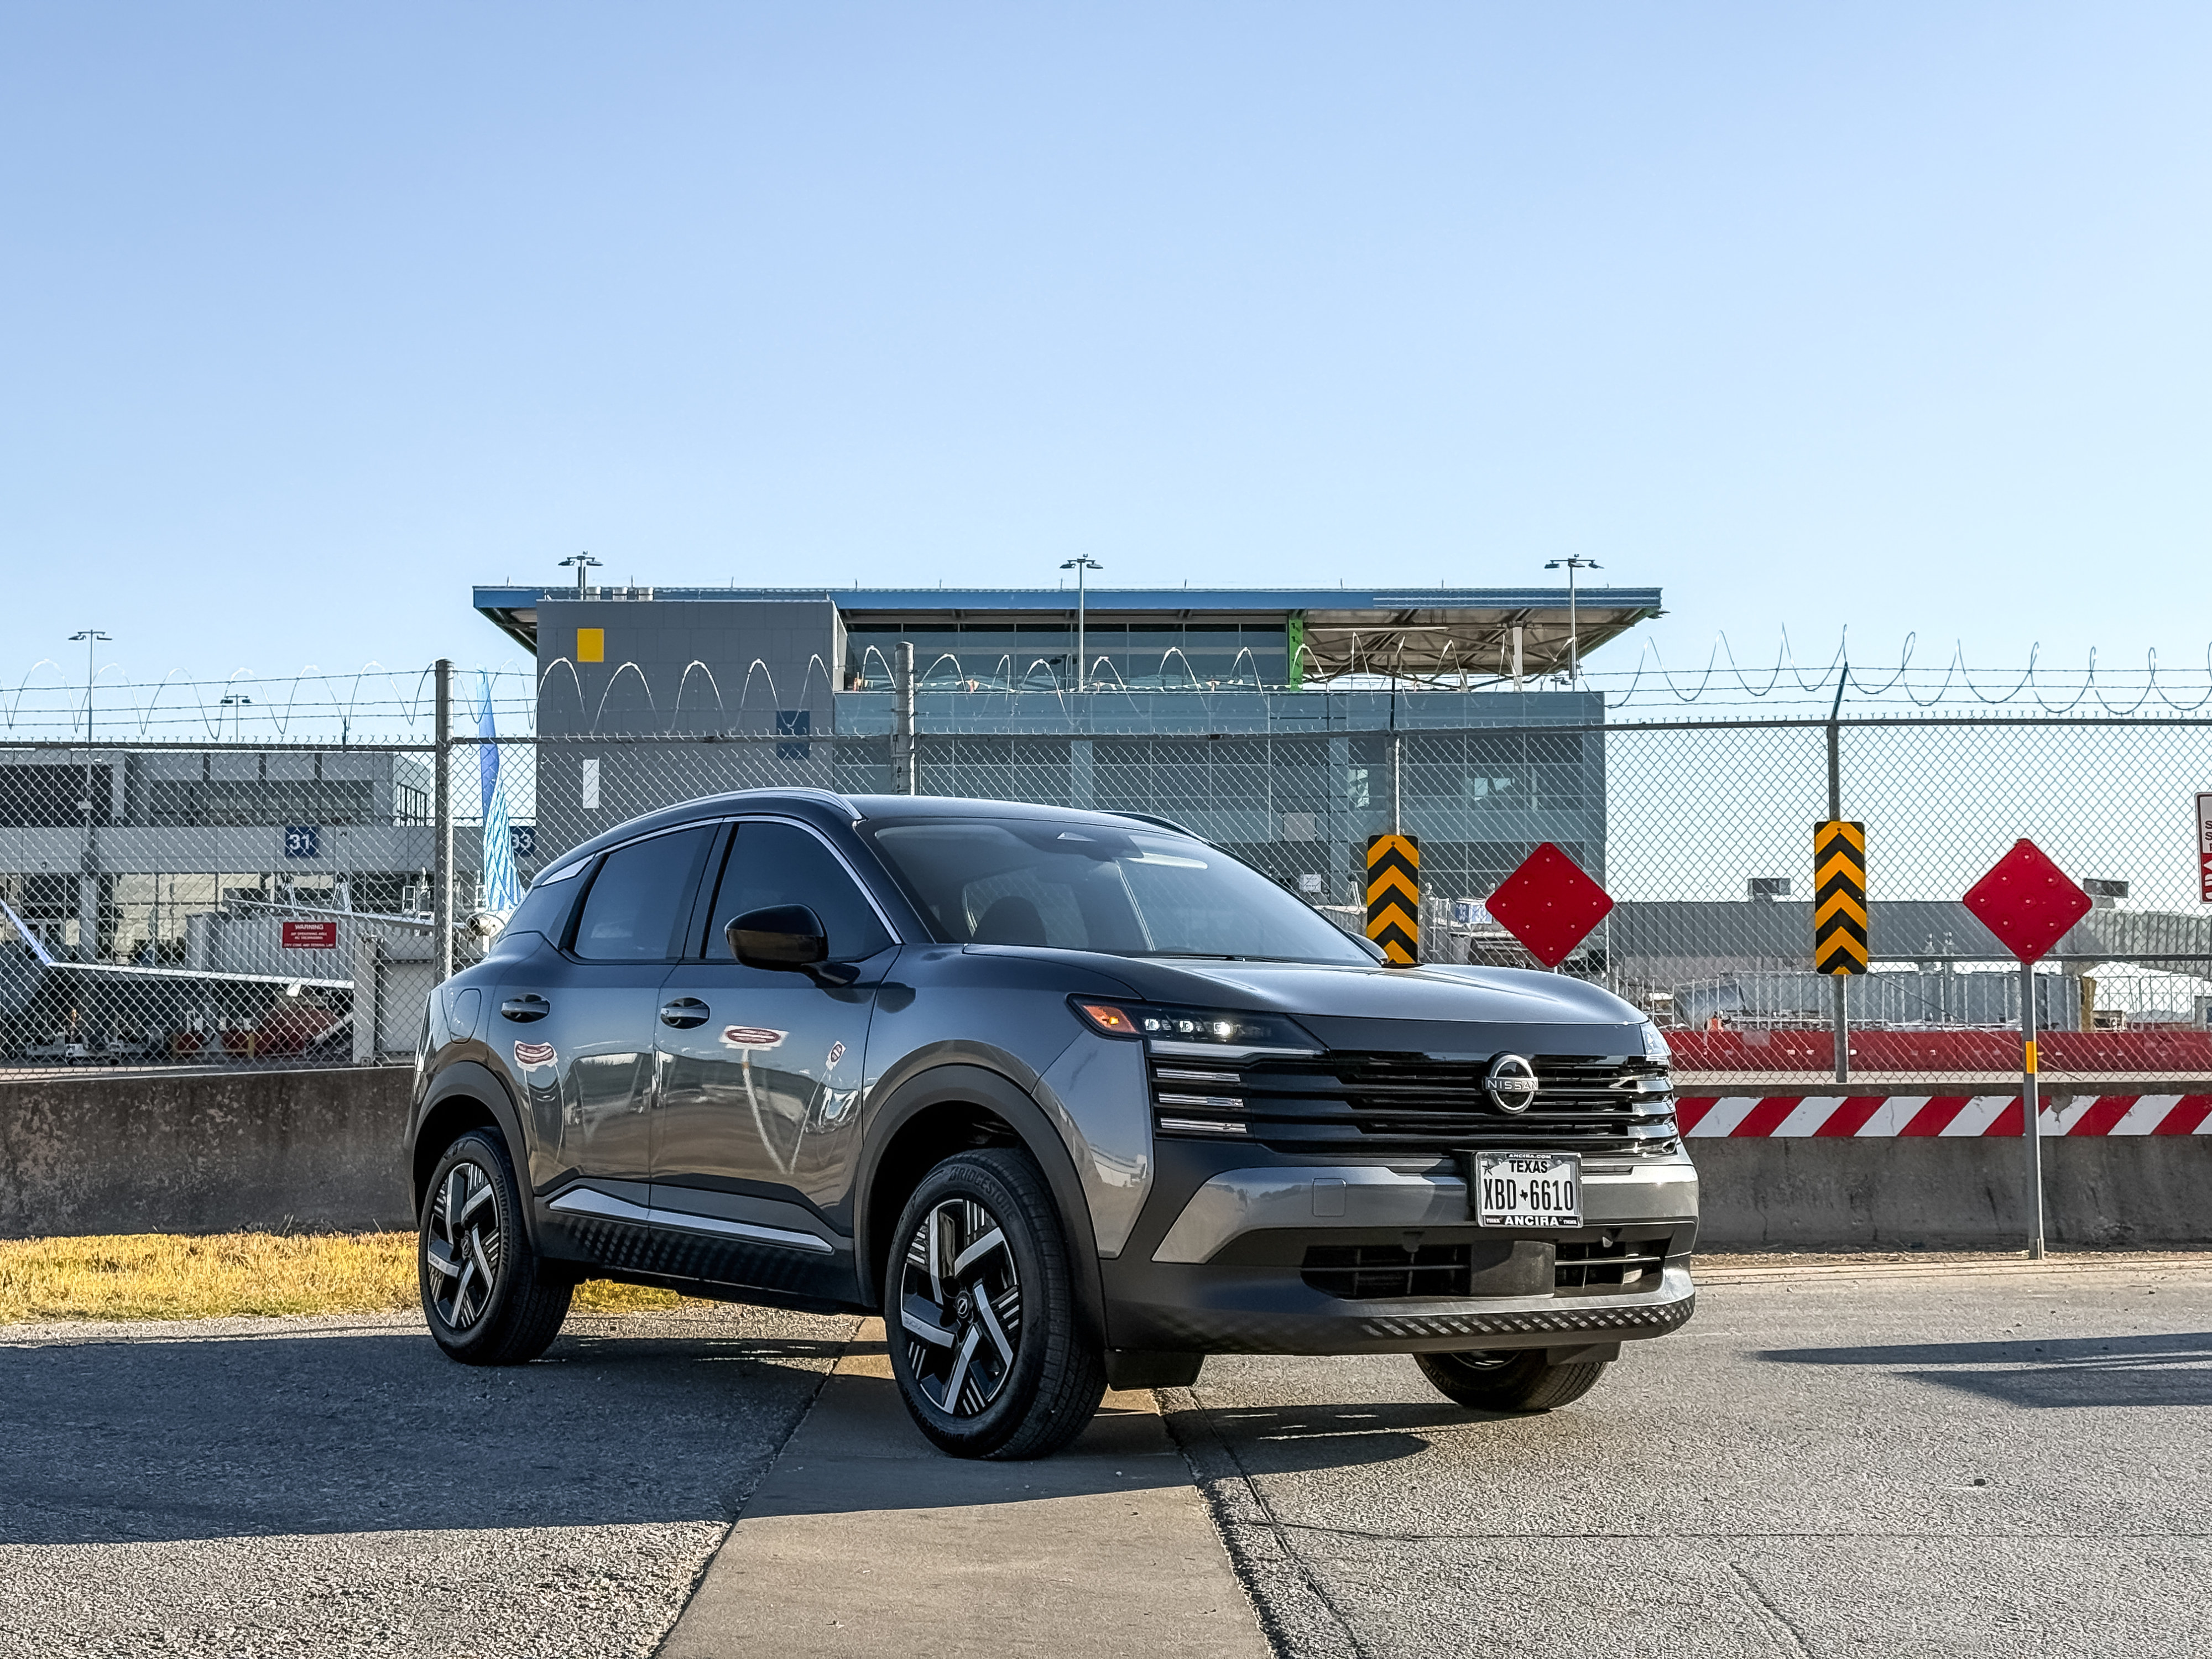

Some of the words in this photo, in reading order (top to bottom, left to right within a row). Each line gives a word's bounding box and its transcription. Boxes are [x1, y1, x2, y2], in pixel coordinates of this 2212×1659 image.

[289, 834, 310, 850] 31
[1488, 1079, 1538, 1091] NISSAN
[1509, 1160, 1548, 1173] TEXAS
[948, 1165, 1018, 1222] BRIDGESTONE
[1484, 1178, 1517, 1210] XBD
[1530, 1179, 1574, 1211] 6610
[495, 1174, 510, 1272] BRIDGESTONE
[1505, 1216, 1559, 1227] ANCIRA
